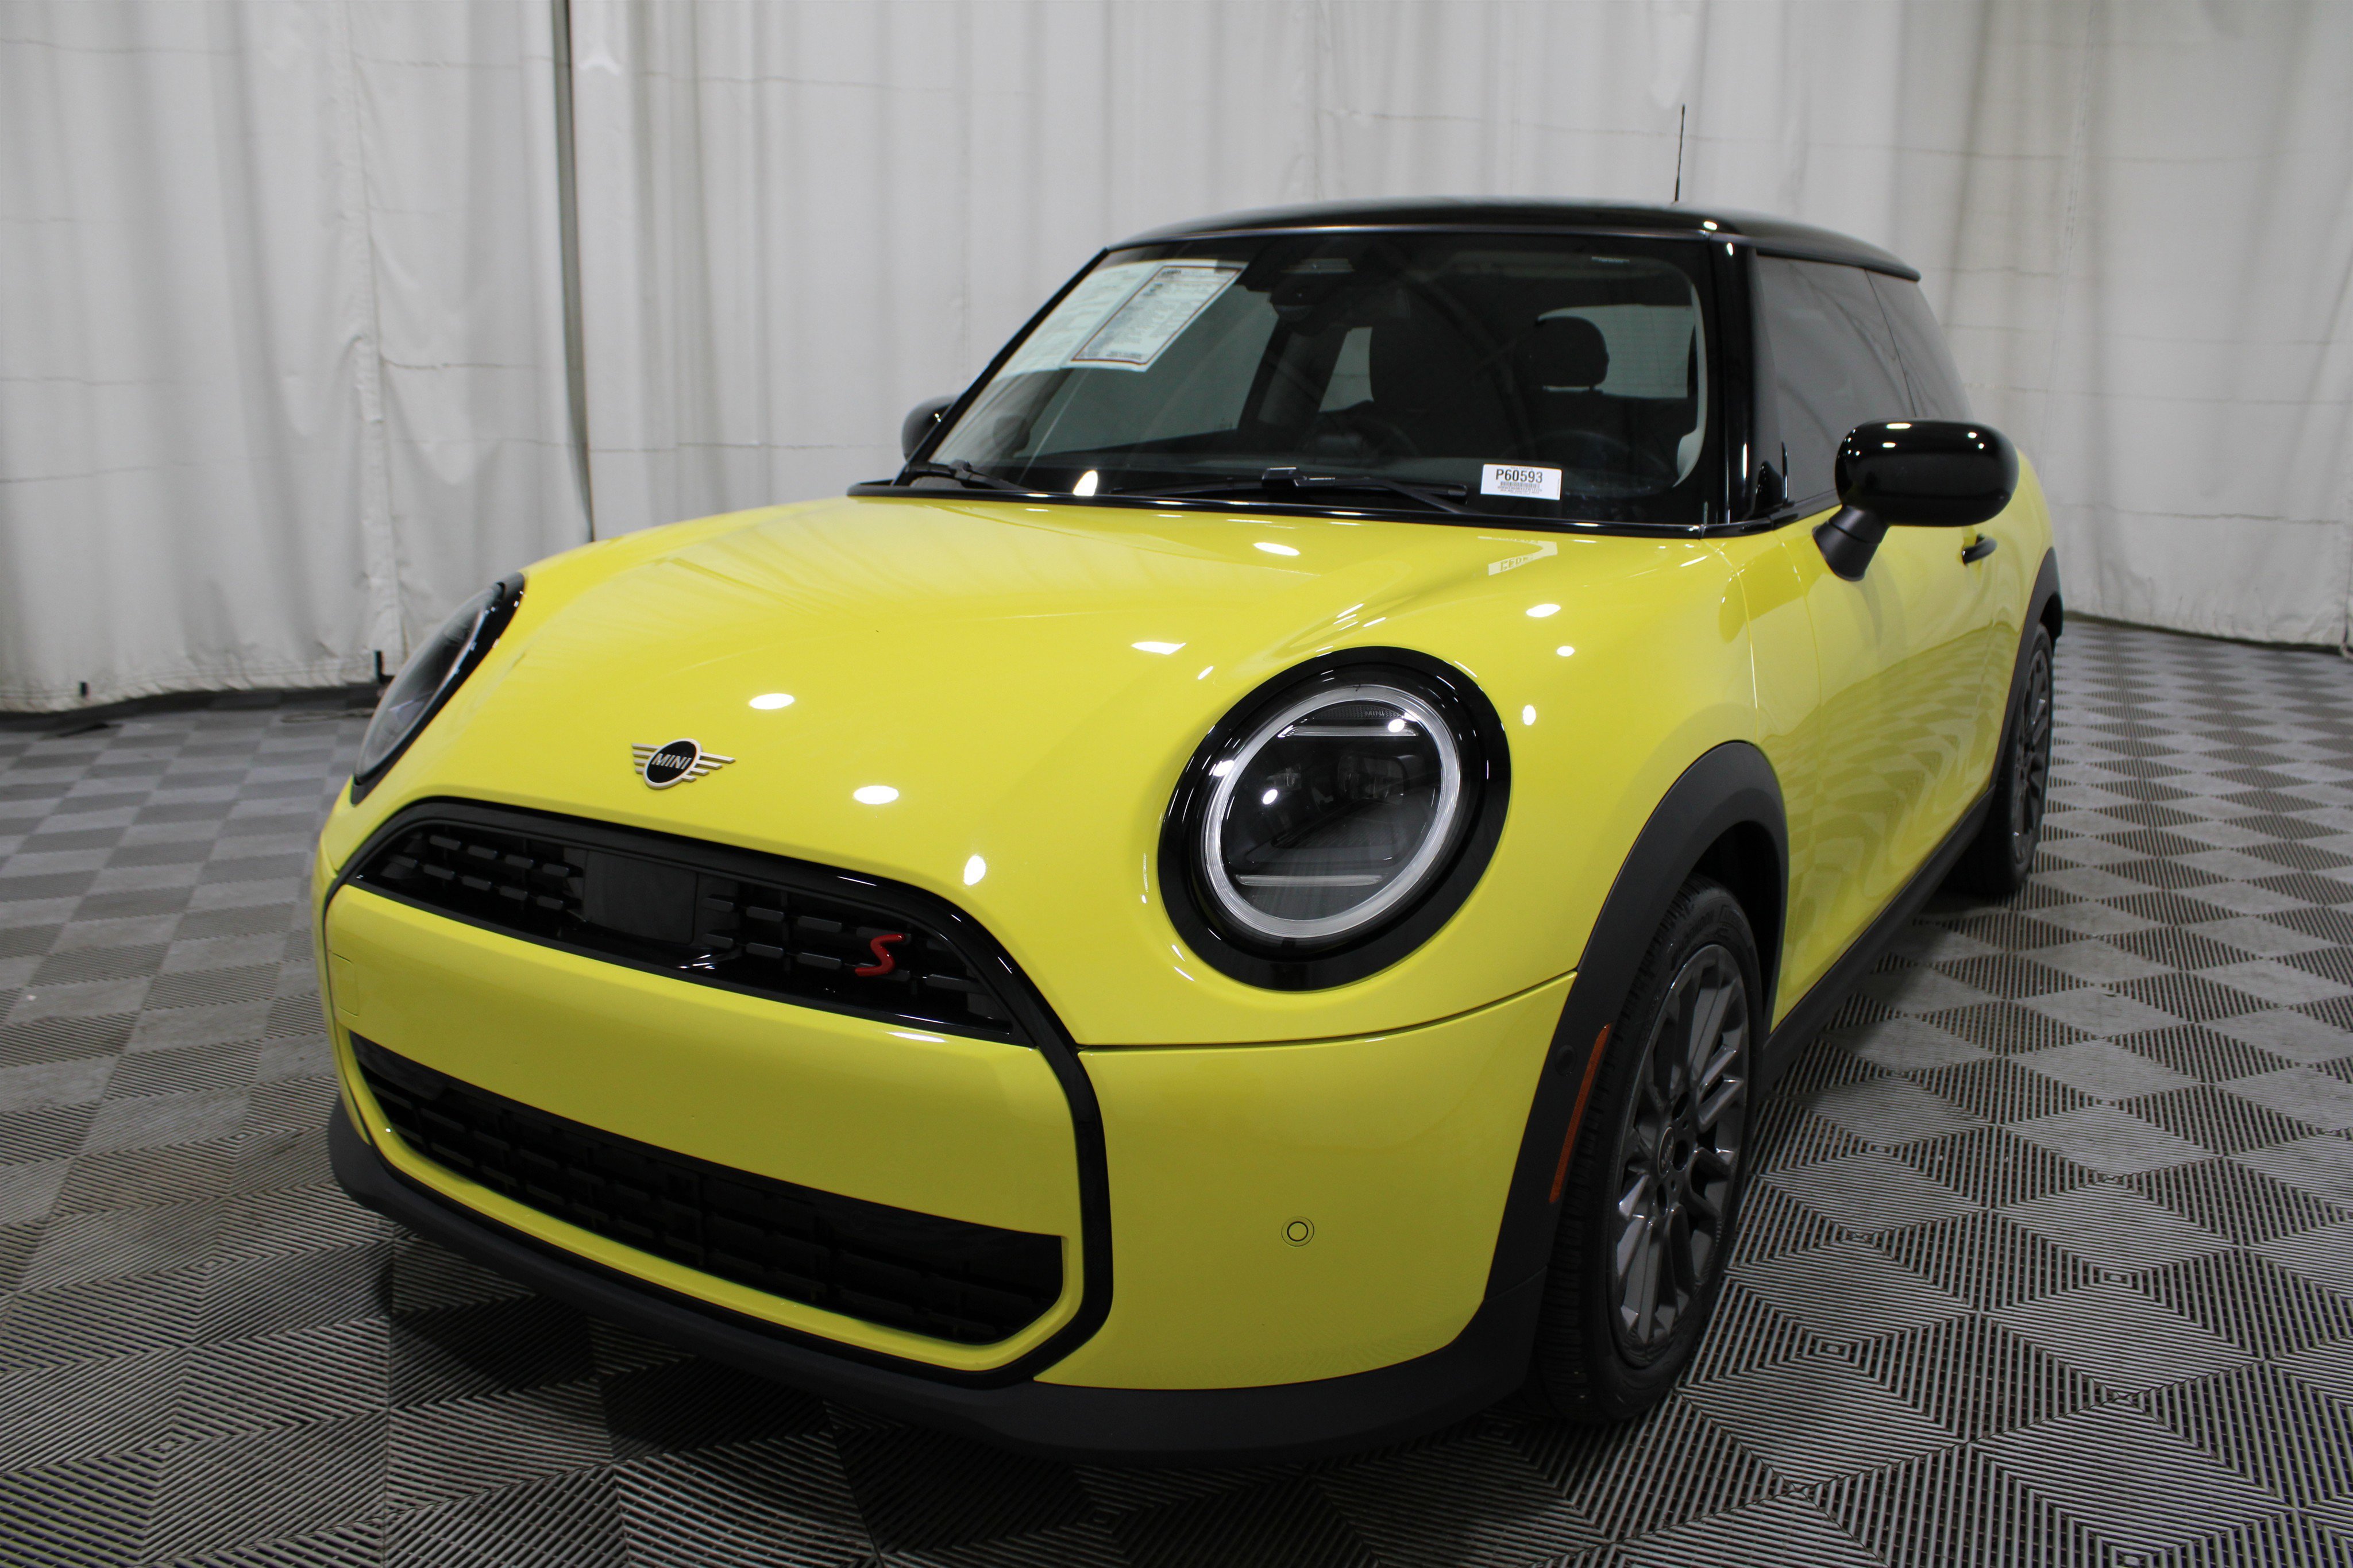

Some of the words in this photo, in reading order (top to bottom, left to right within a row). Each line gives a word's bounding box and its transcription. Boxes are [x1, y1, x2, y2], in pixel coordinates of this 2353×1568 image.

[1495, 468, 1543, 484] P60593
[651, 753, 692, 770] MINI
[855, 933, 905, 977] S
